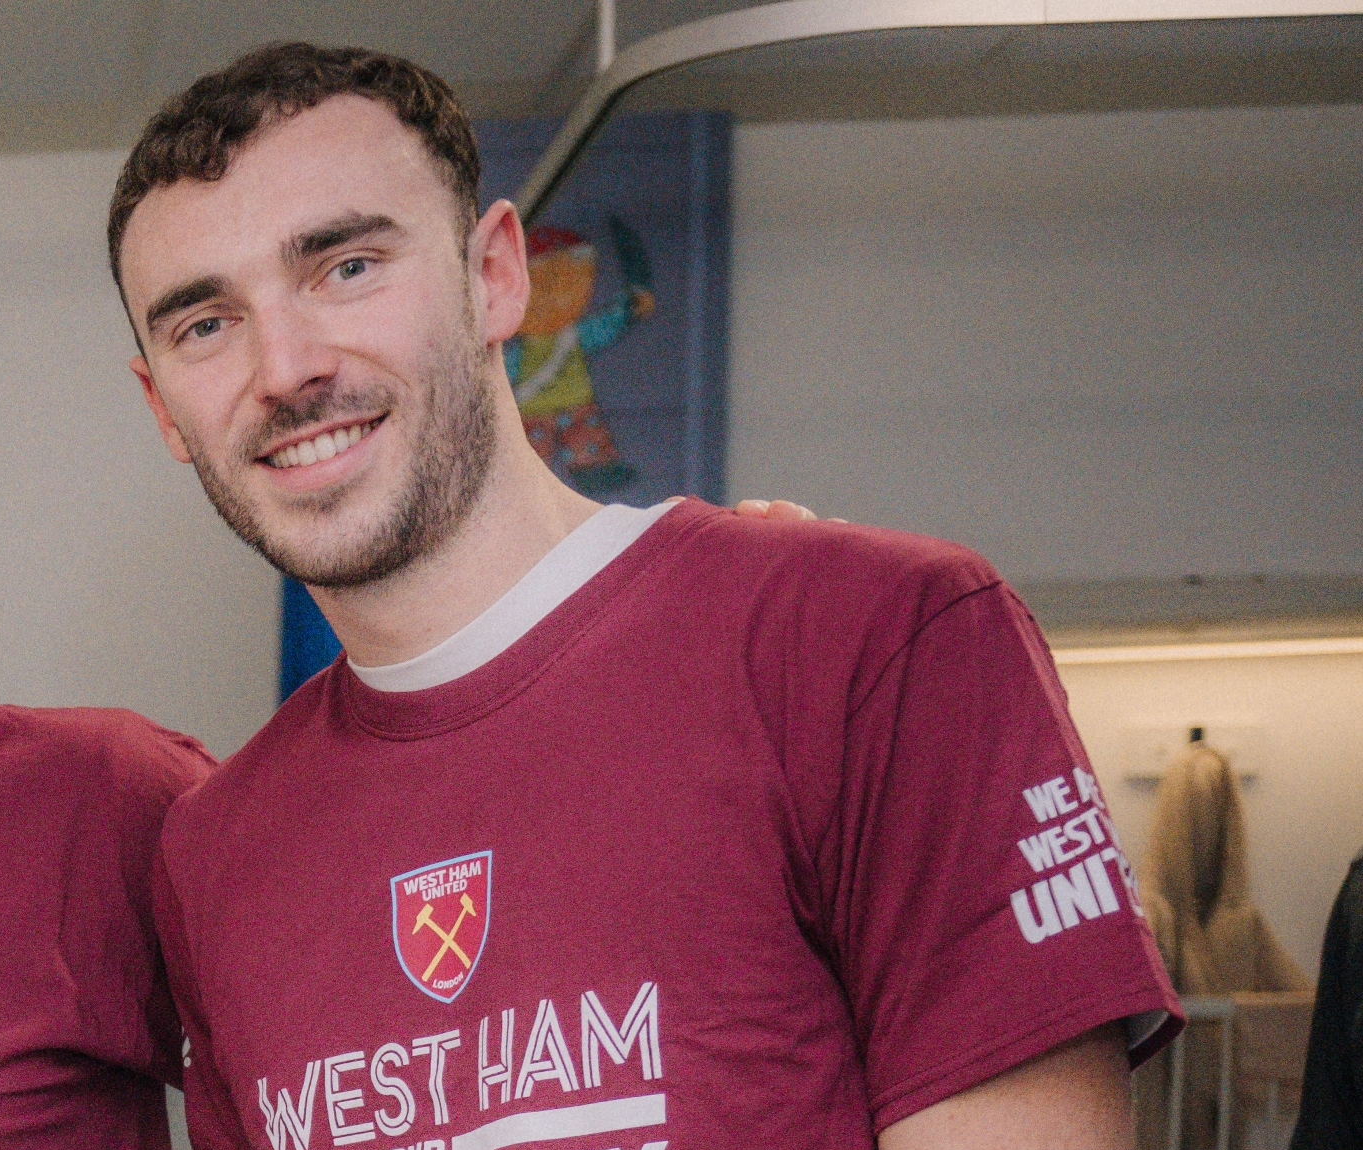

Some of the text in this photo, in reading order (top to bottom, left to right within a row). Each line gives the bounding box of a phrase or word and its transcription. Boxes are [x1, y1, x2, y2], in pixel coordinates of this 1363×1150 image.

[1022, 776, 1079, 824] WE
[1017, 807, 1106, 873] WEST
[403, 860, 482, 896] WEST HAM
[422, 879, 468, 902] UNITED
[432, 970, 464, 990] LONDON
[478, 981, 664, 1112] HAM
